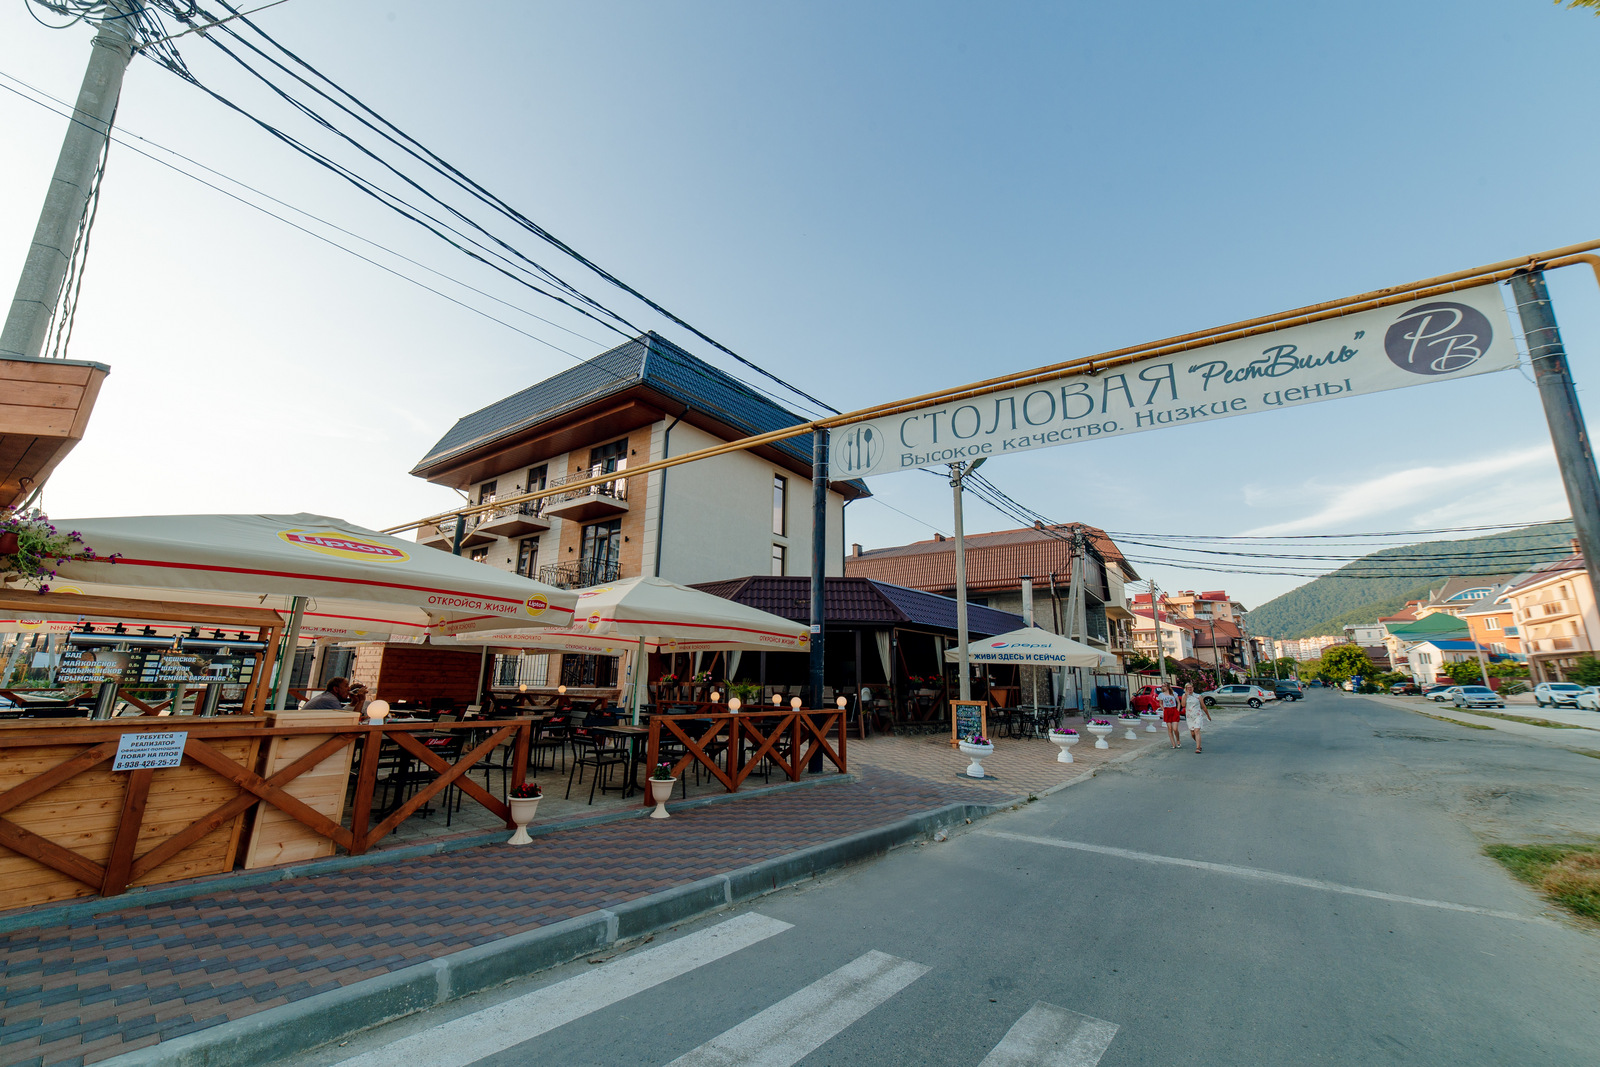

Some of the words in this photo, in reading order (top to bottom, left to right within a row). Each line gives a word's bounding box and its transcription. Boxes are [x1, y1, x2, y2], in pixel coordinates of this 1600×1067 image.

[900, 362, 1180, 449] СТОЛОВАЯ
[901, 442, 993, 468] Высокое
[1002, 420, 1125, 451] качество.
[1135, 397, 1248, 428] Низкие
[1262, 377, 1353, 407] цены
[297, 534, 395, 556] Lipton
[428, 595, 482, 610] ОТКРОЙСЯ
[484, 602, 518, 614] ЖИЗНИ
[528, 601, 546, 609] Lipton
[62, 660, 118, 668] МАЙКОПСКОЕ
[998, 653, 1025, 661] ЗДЕСЬ
[1033, 653, 1066, 662] СЕЙЧАС
